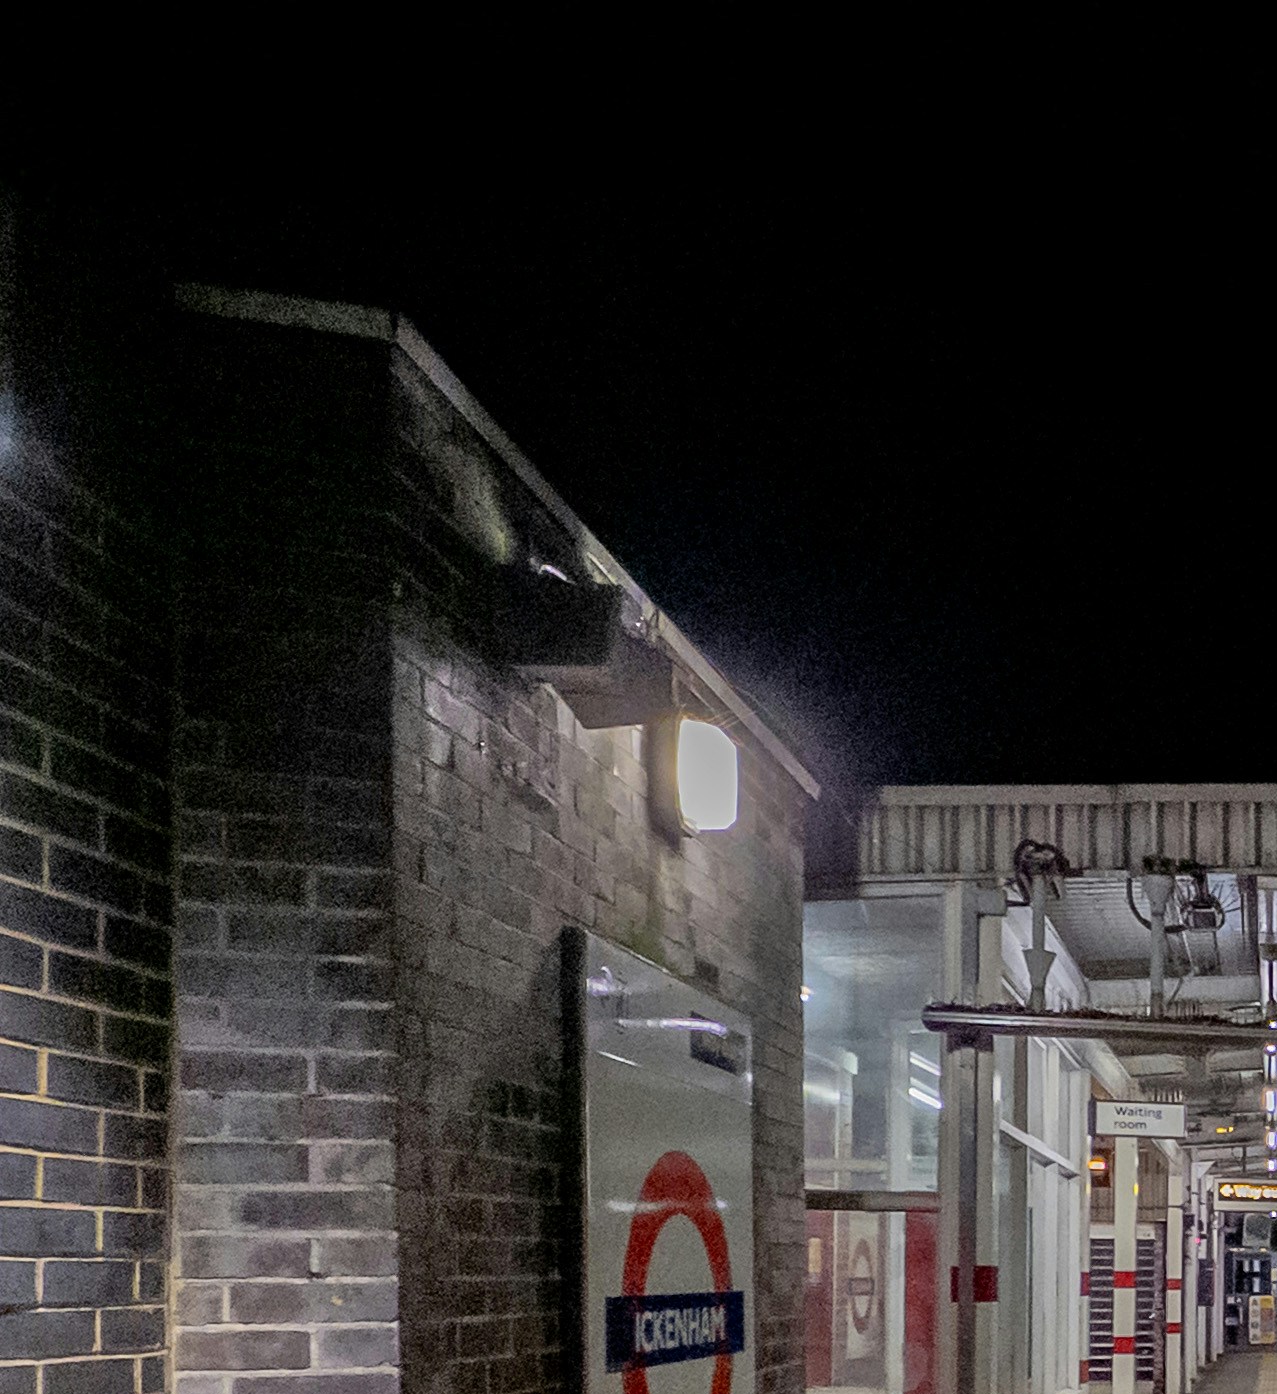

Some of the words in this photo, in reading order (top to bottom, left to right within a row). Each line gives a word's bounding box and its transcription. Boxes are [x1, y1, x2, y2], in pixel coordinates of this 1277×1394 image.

[1114, 1106, 1162, 1119] Waiting
[1114, 1121, 1147, 1129] room
[634, 1304, 726, 1354] ICKENHAM
